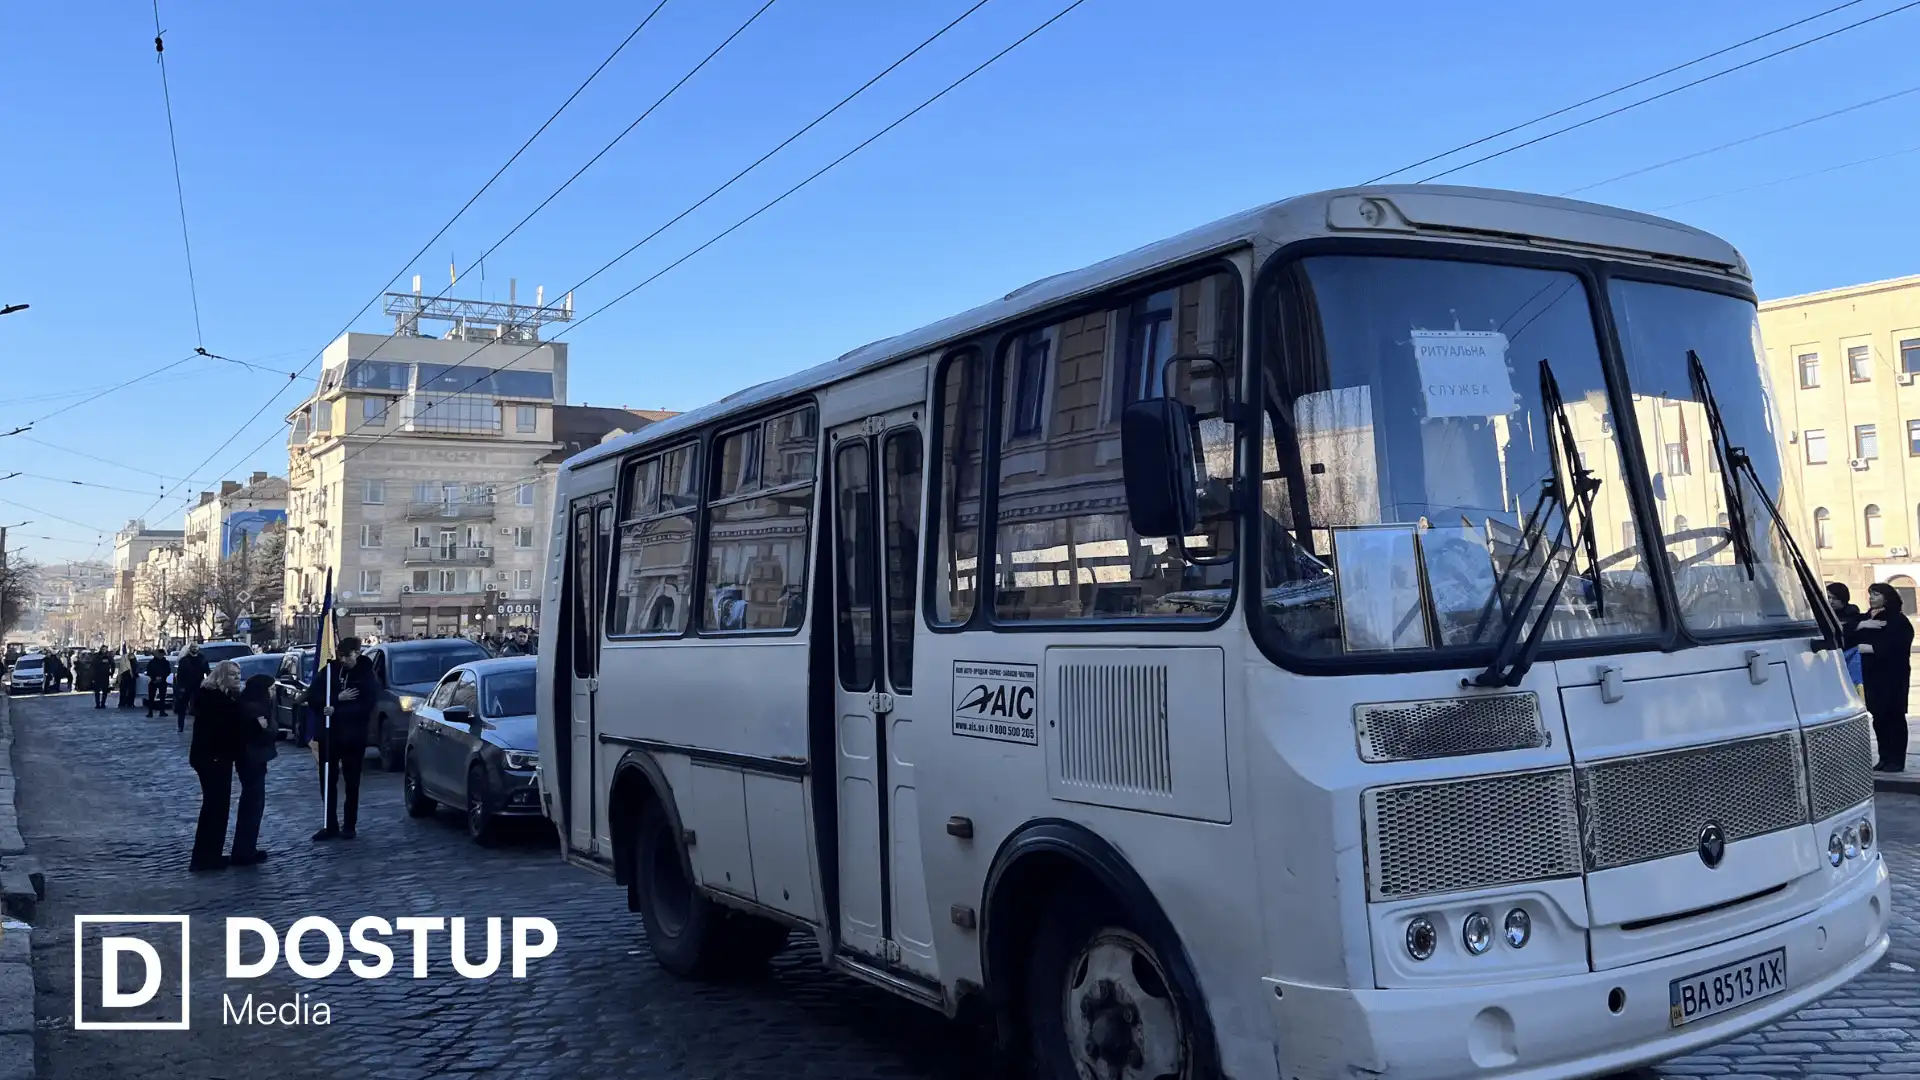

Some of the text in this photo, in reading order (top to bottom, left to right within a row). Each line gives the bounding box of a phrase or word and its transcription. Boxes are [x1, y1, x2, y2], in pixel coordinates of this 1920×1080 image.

[1421, 346, 1486, 357] РИТУАЛЬНА
[1428, 384, 1491, 396] СЛУЖБА
[498, 604, 539, 613] GOGOL
[989, 724, 993, 733] 0
[995, 725, 1006, 735] 800
[1008, 726, 1020, 737] 500
[1021, 728, 1034, 738] 205
[1682, 957, 1782, 1017] BA 8513 AX
